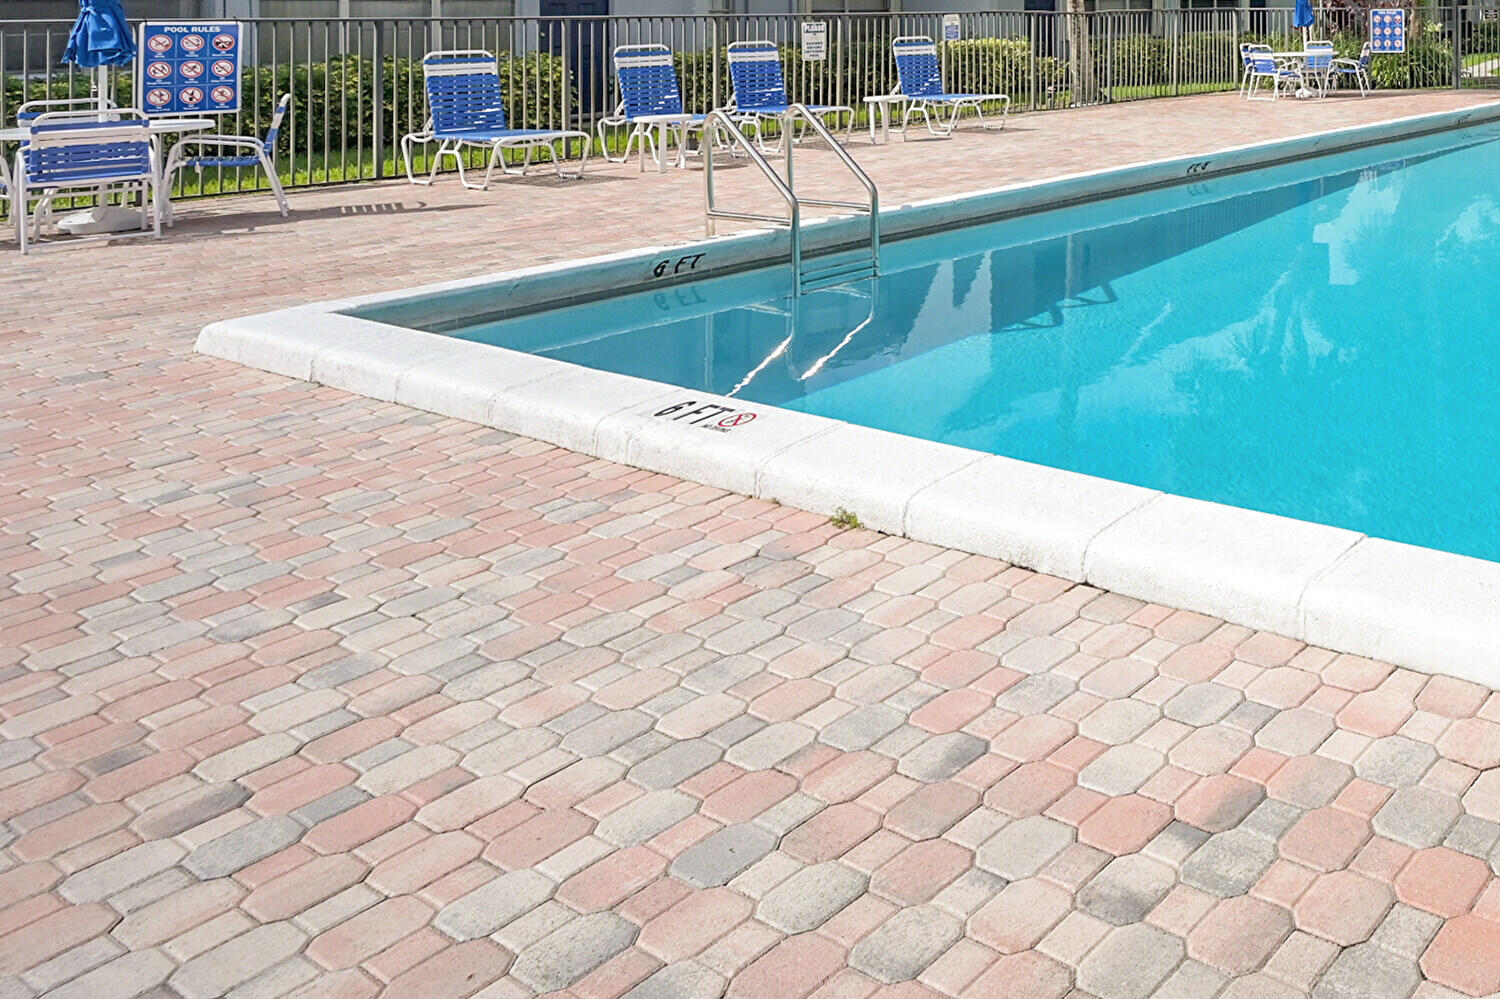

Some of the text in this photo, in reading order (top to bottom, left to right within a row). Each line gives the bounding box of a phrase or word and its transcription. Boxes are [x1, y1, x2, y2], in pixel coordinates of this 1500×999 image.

[804, 23, 825, 32] PLEASE
[653, 252, 707, 277] 6 FT
[653, 401, 735, 424] 6 FT
